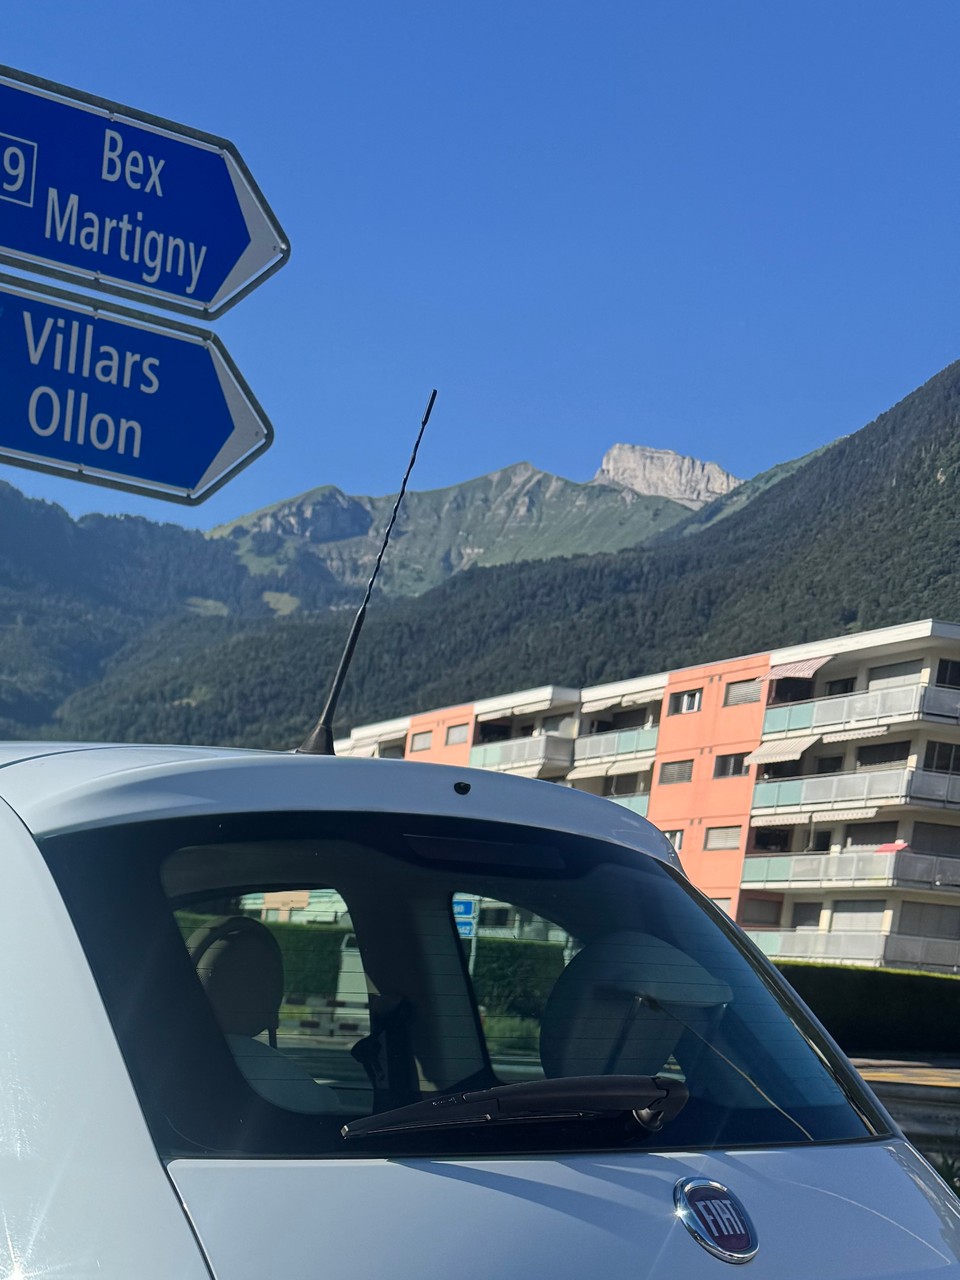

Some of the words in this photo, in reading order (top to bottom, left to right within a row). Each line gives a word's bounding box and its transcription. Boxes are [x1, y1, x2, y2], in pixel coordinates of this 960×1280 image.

[2, 146, 26, 192] 9
[101, 129, 166, 197] Bex
[44, 187, 207, 294] Martigny
[23, 311, 160, 394] Villars
[28, 386, 142, 458] Ollon
[695, 1199, 746, 1237] FIAT
